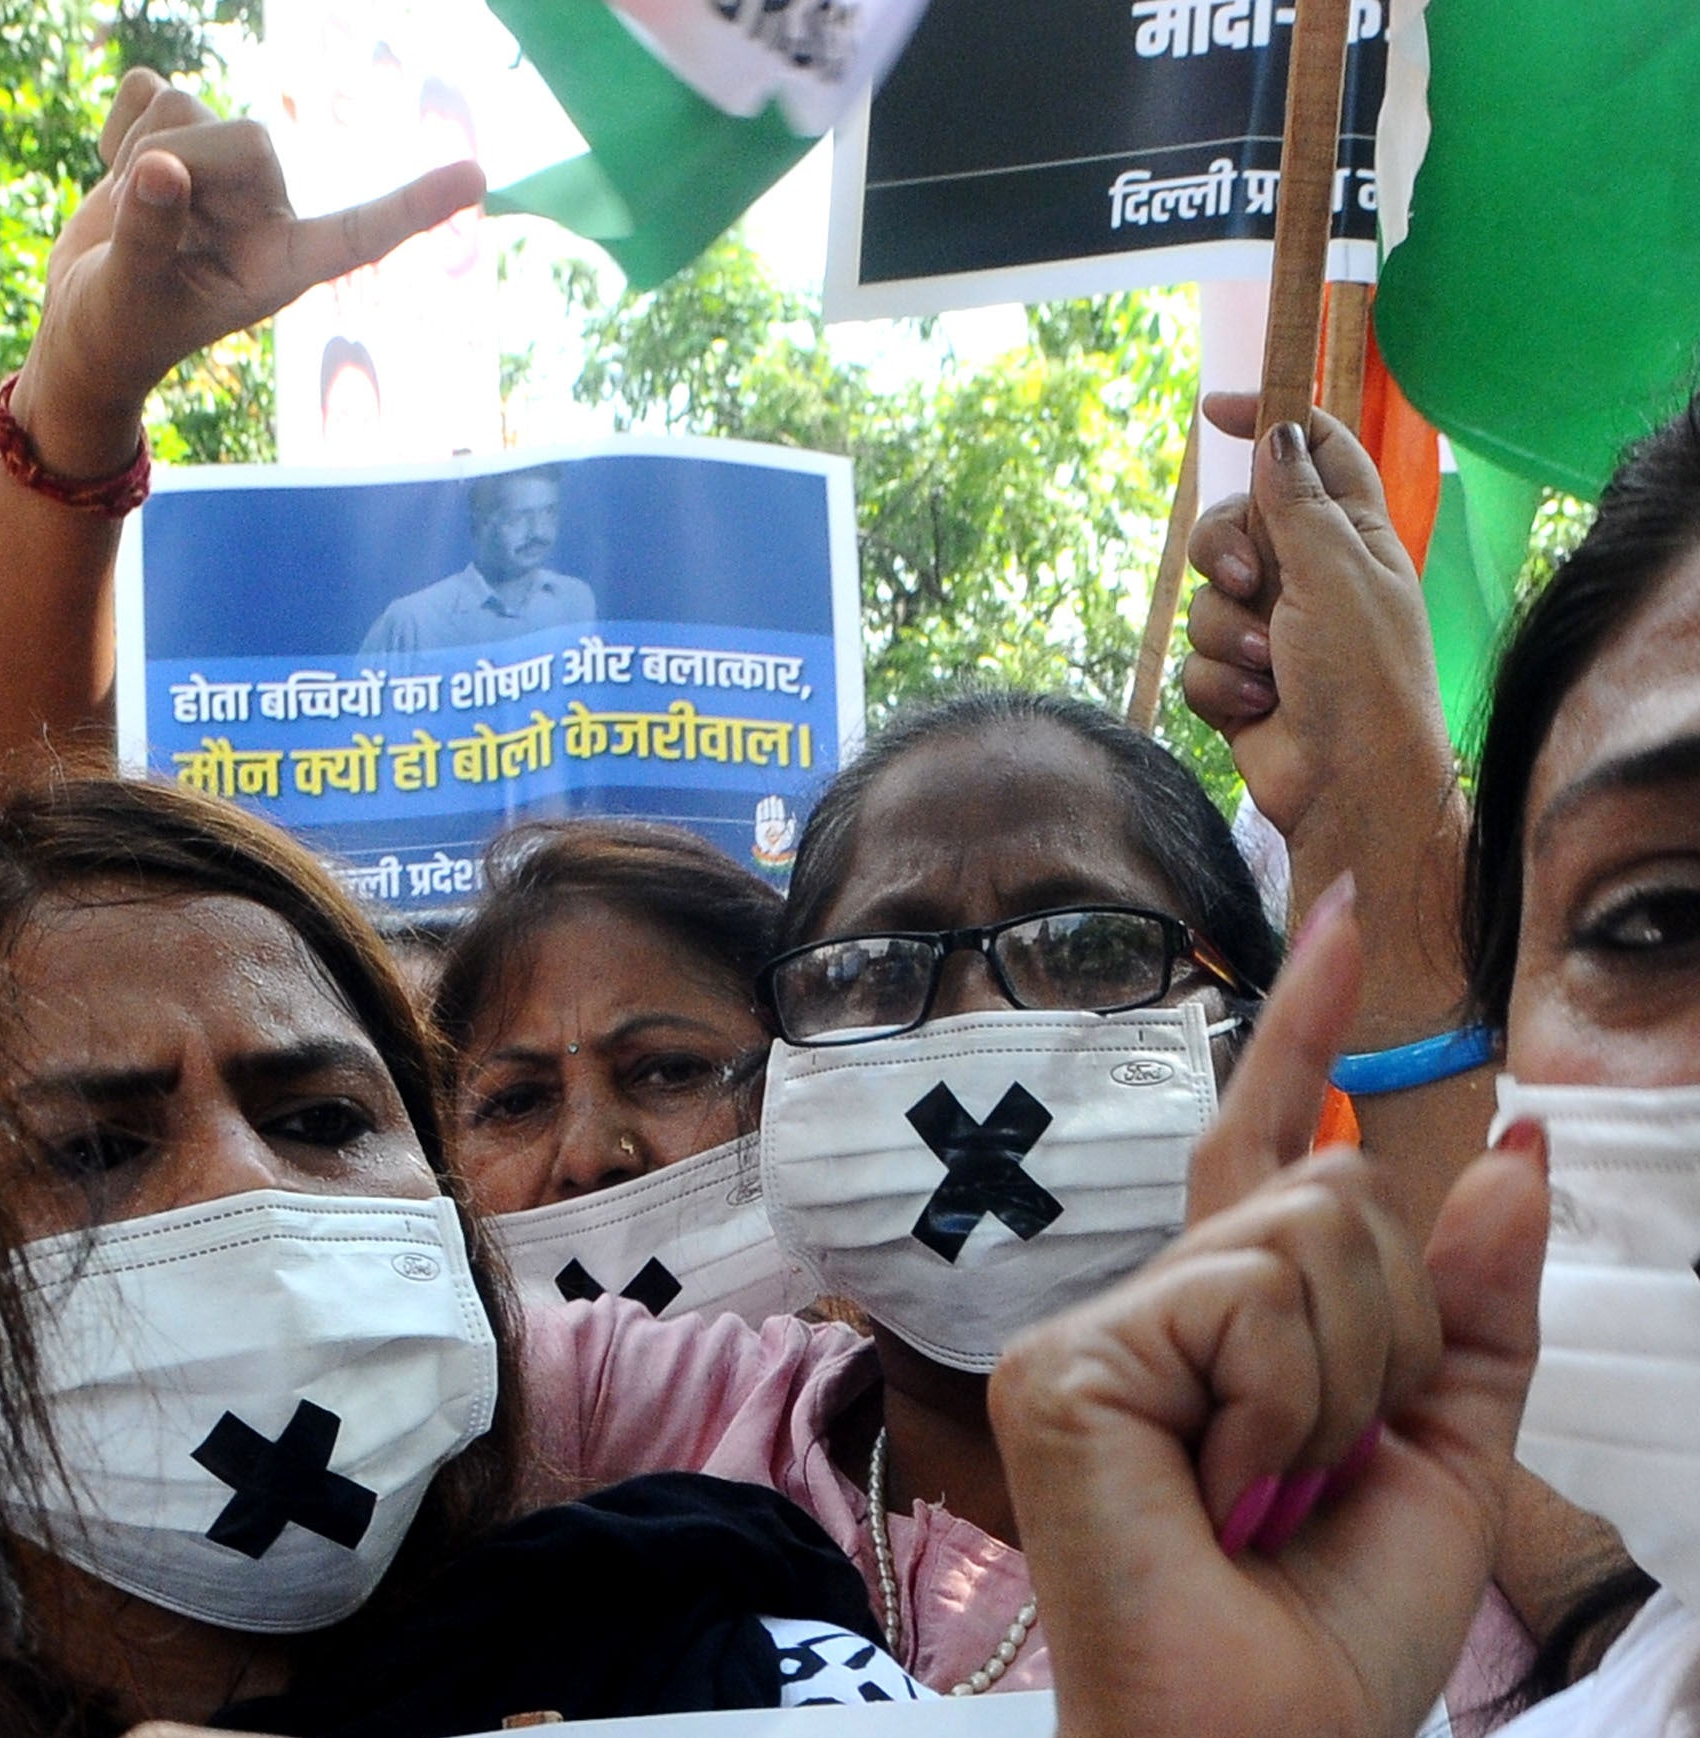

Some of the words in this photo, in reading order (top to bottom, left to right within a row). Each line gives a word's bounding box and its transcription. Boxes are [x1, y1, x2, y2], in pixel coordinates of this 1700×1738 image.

[1109, 157, 1238, 230] दिल्ली
[169, 673, 253, 723] होता
[256, 669, 387, 721] बच्चियों
[389, 674, 442, 715] का
[450, 655, 554, 710] शोषण
[562, 636, 635, 685] और
[638, 645, 812, 702] बलात्कार,
[172, 736, 283, 798] मौन
[290, 732, 384, 796] क्यों
[388, 728, 441, 790] हो
[449, 709, 556, 784] बोलो
[406, 851, 484, 896] प्रदेश
